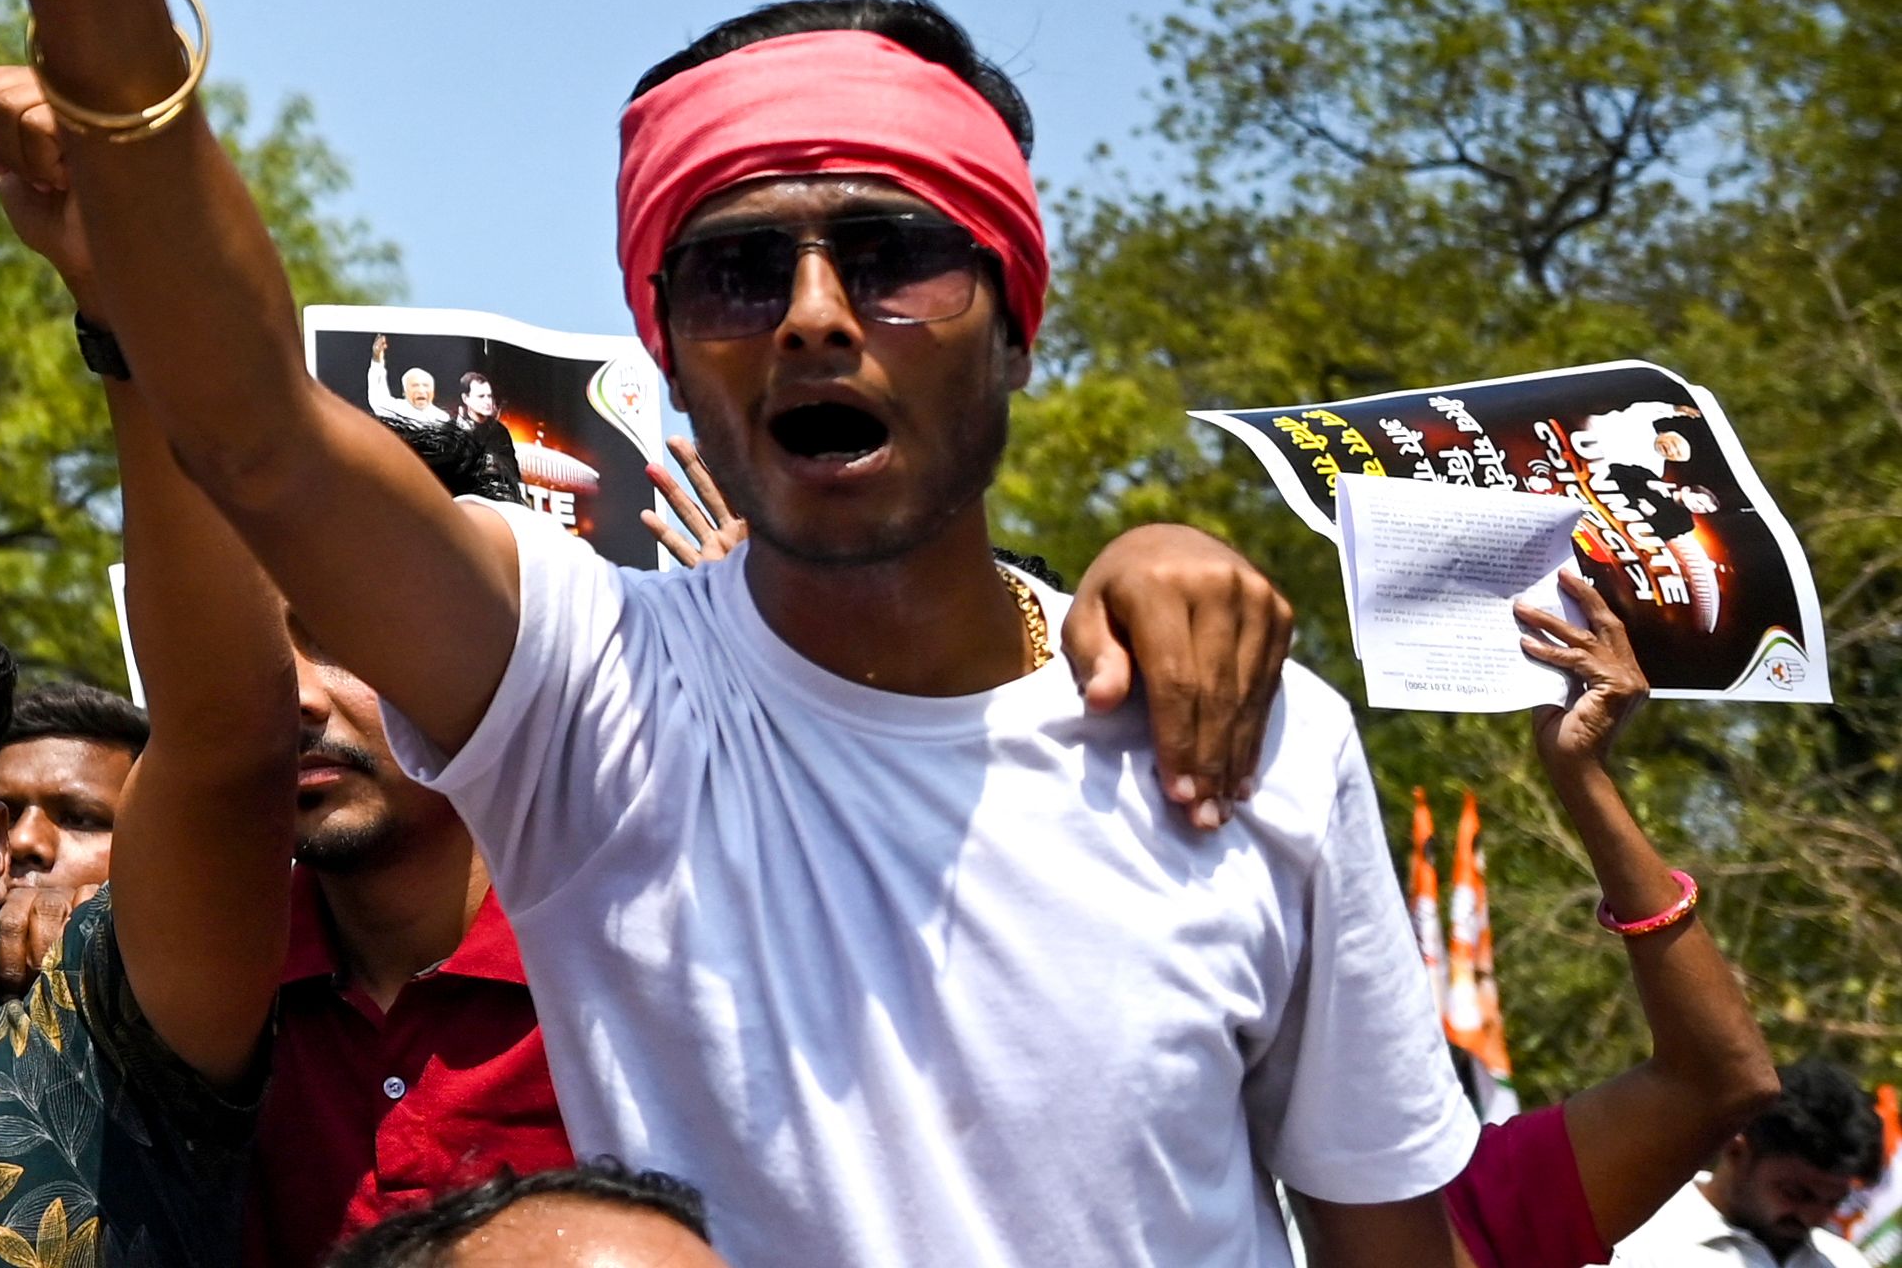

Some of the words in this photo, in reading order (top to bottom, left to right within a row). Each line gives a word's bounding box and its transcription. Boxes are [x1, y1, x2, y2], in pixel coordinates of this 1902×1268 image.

[1272, 415, 1328, 452] मोदी
[1340, 426, 1374, 456] पर
[1378, 418, 1425, 457] और
[1569, 430, 1691, 605] UNMUTE
